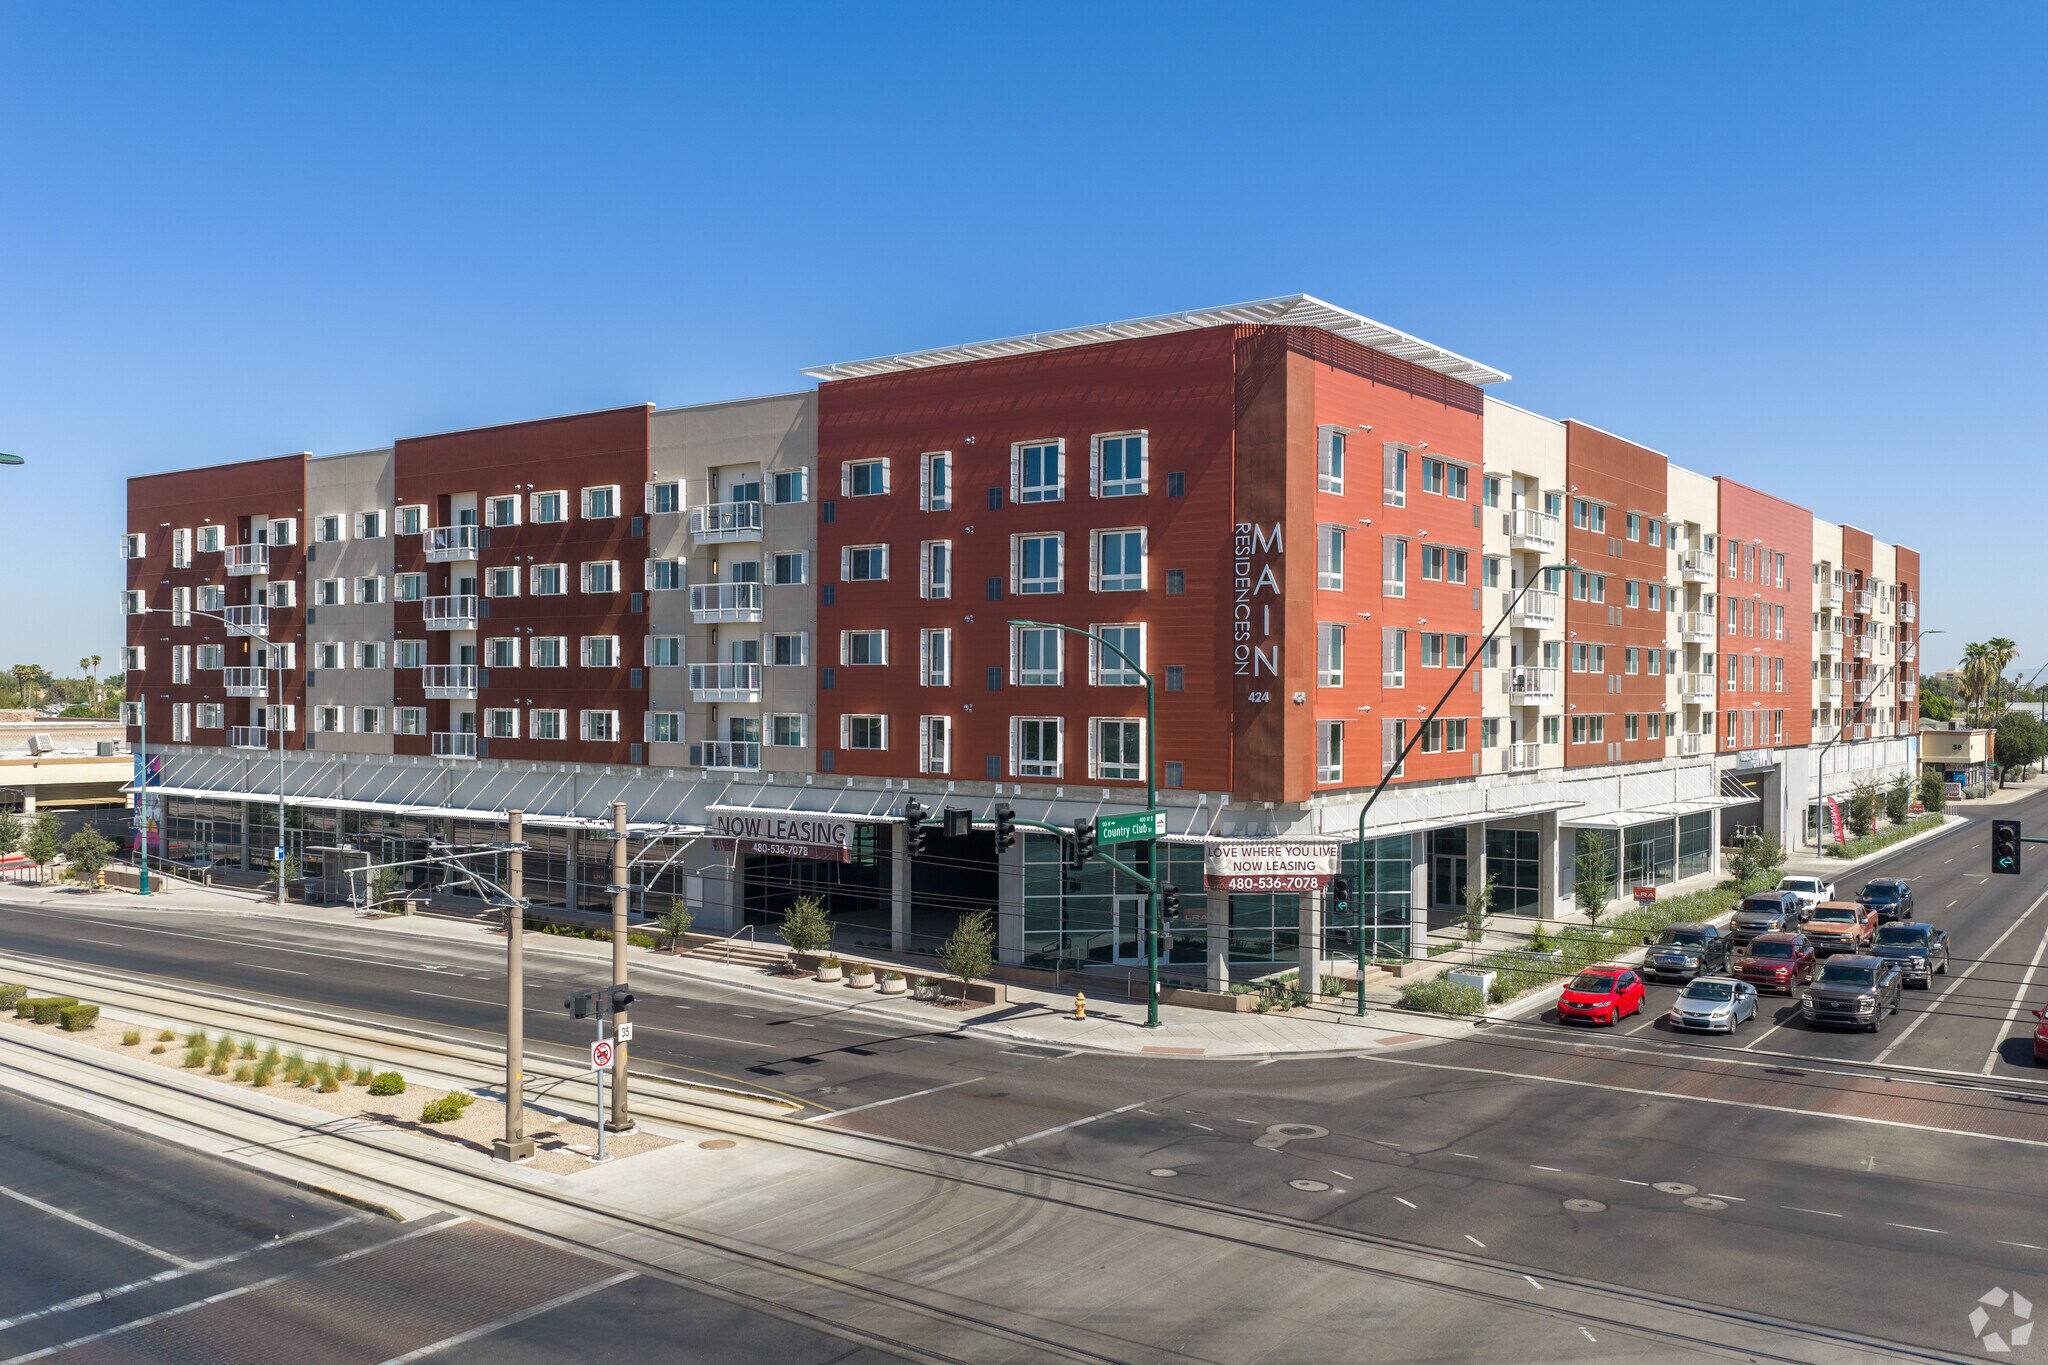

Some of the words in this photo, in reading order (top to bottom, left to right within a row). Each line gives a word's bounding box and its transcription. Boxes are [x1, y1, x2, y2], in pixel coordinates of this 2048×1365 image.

[1234, 522, 1250, 641] RESIDENCES
[1251, 521, 1284, 677] MAIN
[1235, 644, 1250, 676] ON
[1248, 692, 1270, 703] 424
[718, 816, 761, 838] NOW
[767, 819, 846, 844] LEASING
[1103, 826, 1130, 838] Country
[1132, 823, 1147, 835] Club
[752, 842, 809, 857] 480-536-7078
[1208, 847, 1238, 858] LOVE
[1241, 846, 1282, 857] WHERE
[1285, 846, 1309, 857] YOU
[1233, 861, 1262, 871] NOW
[1266, 861, 1316, 871] LEASING
[1228, 877, 1319, 889] 480-536-7078
[621, 1026, 630, 1038] 35
